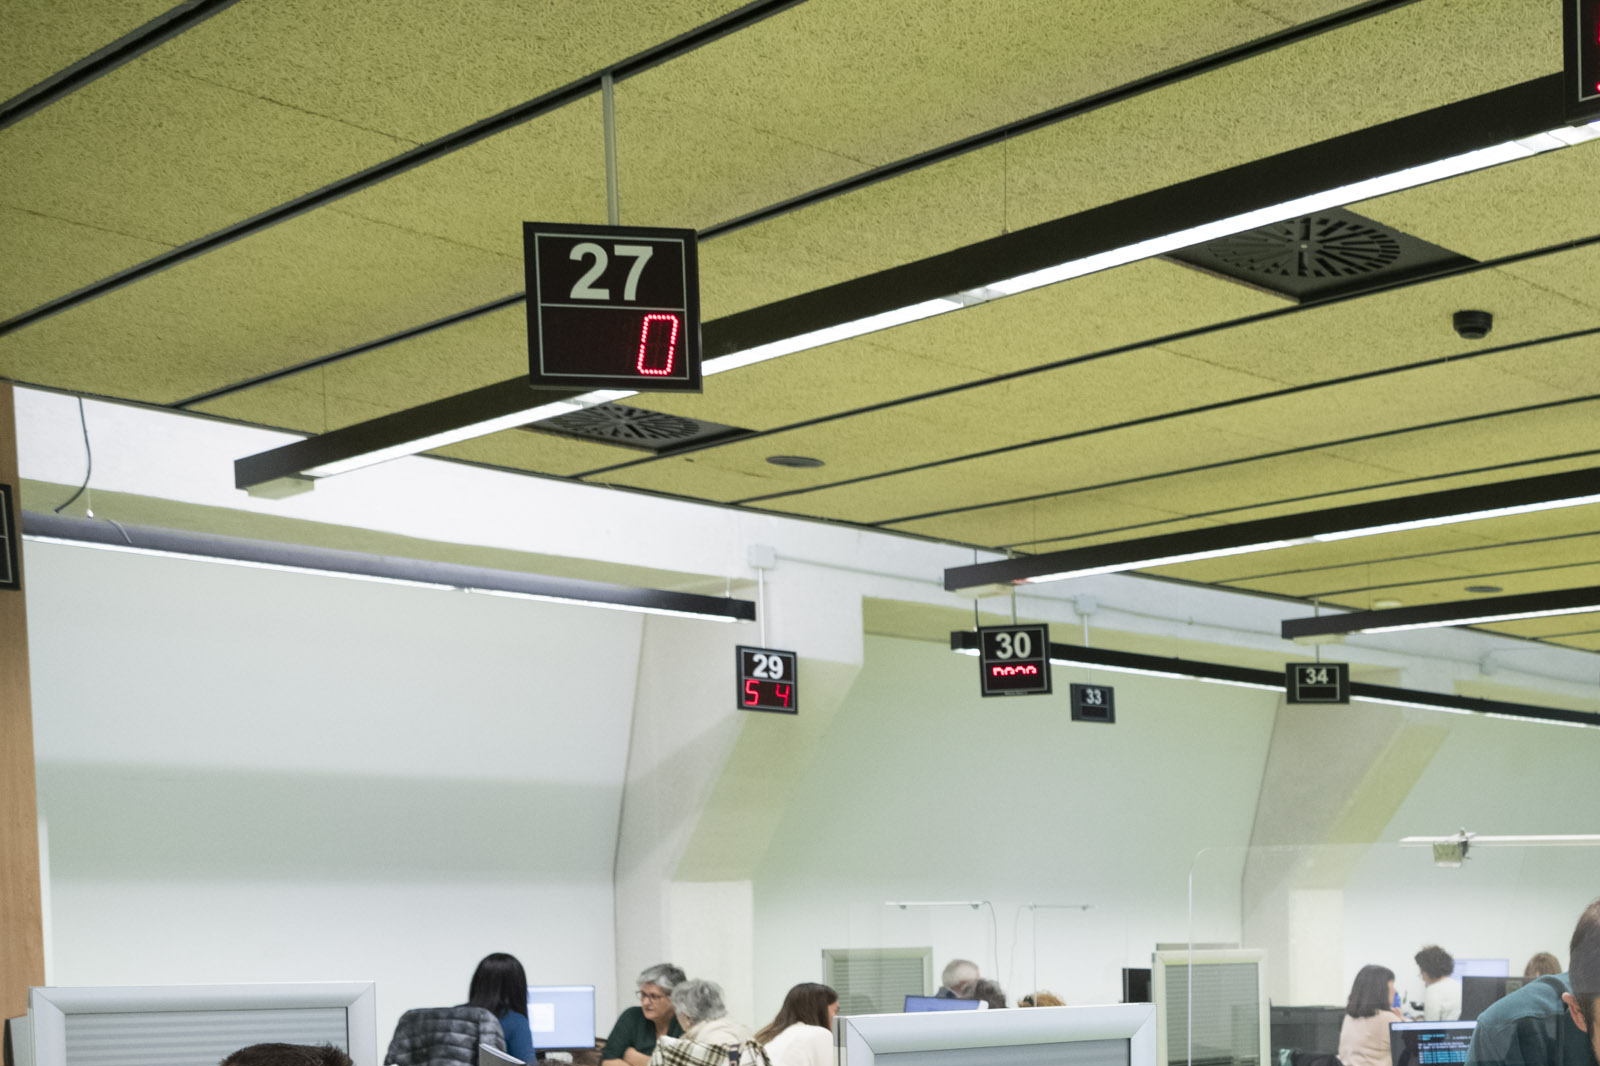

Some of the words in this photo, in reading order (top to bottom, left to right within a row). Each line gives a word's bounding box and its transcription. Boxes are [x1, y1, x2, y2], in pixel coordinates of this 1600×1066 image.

[569, 242, 654, 301] 27
[637, 314, 679, 376] 0
[995, 631, 1032, 660] 30
[752, 653, 784, 680] 29
[1306, 667, 1329, 685] 34
[1086, 688, 1102, 705] 33
